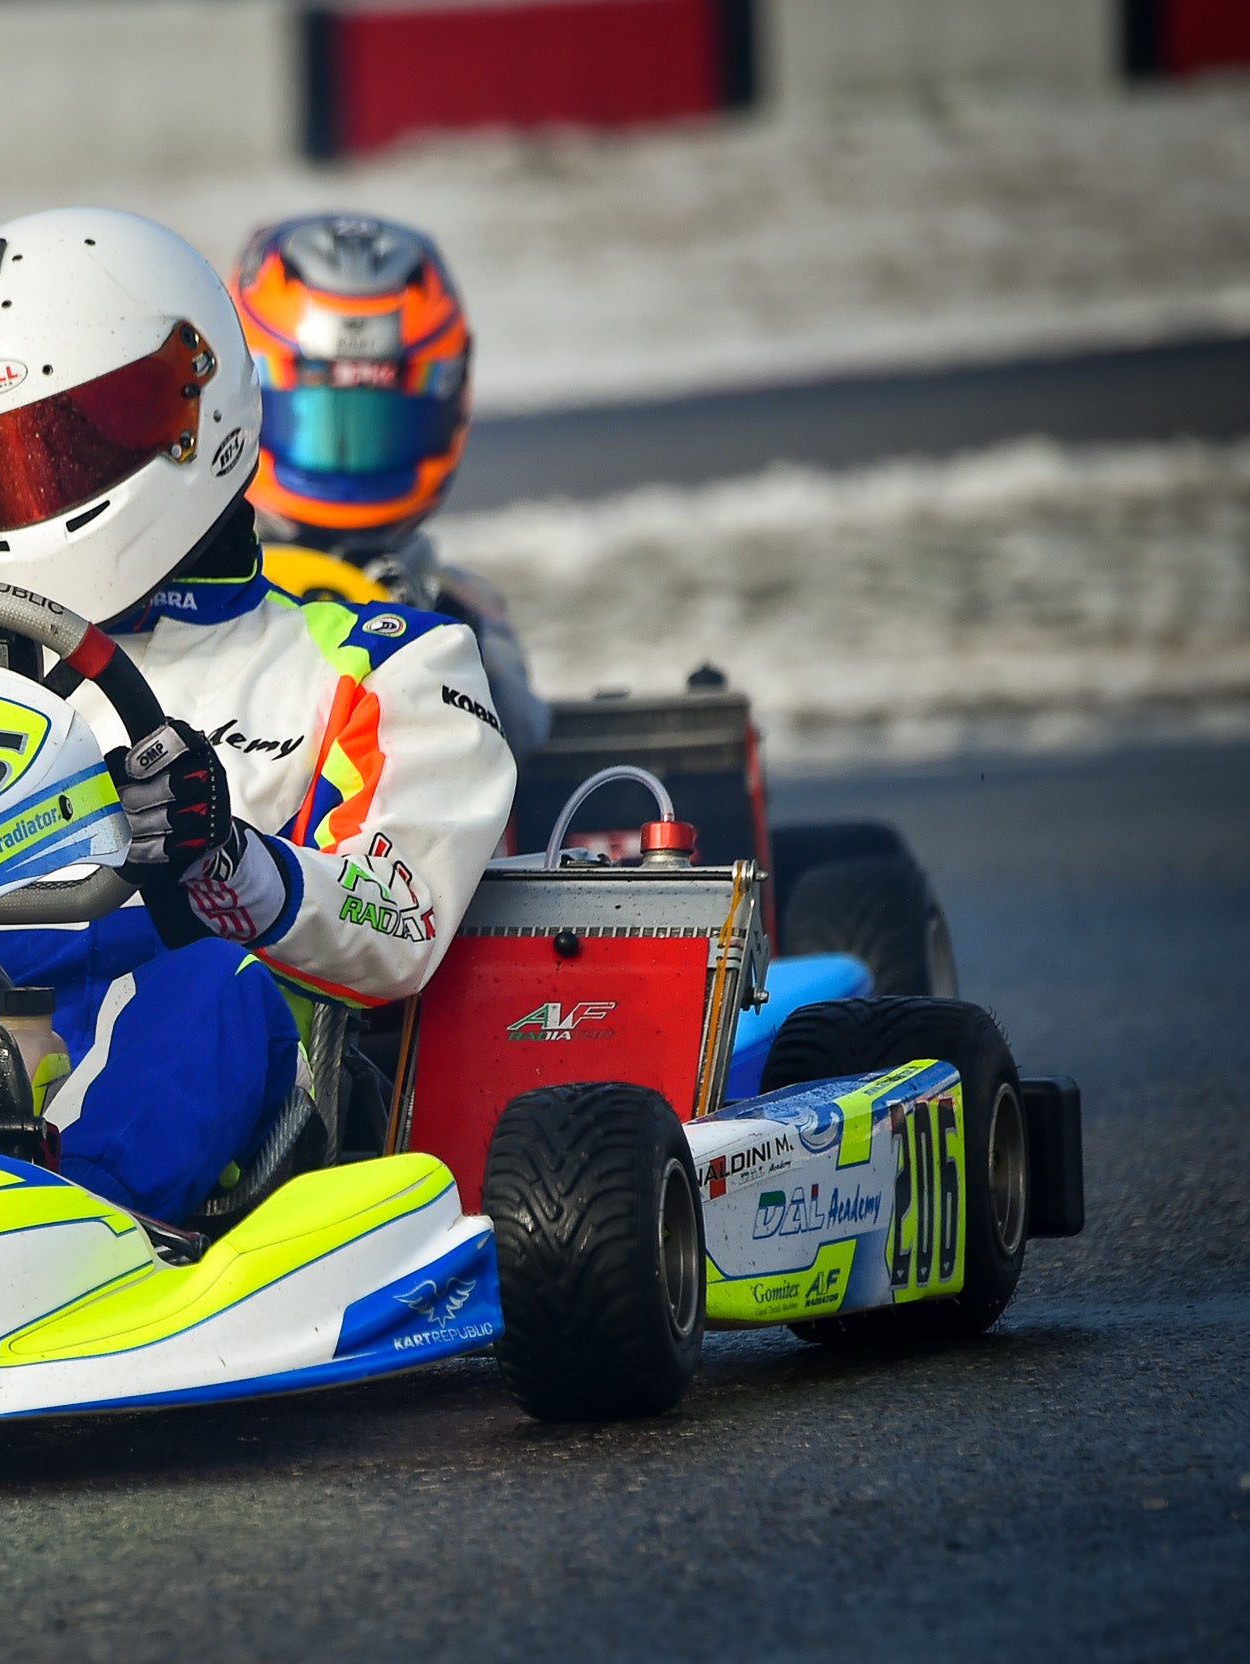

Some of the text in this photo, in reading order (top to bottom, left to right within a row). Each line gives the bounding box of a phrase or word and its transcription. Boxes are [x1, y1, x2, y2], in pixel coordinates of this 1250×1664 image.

[139, 743, 164, 767] OMP
[207, 719, 305, 761] demy
[752, 1184, 882, 1240] DAL Academy
[888, 1097, 960, 1290] 206
